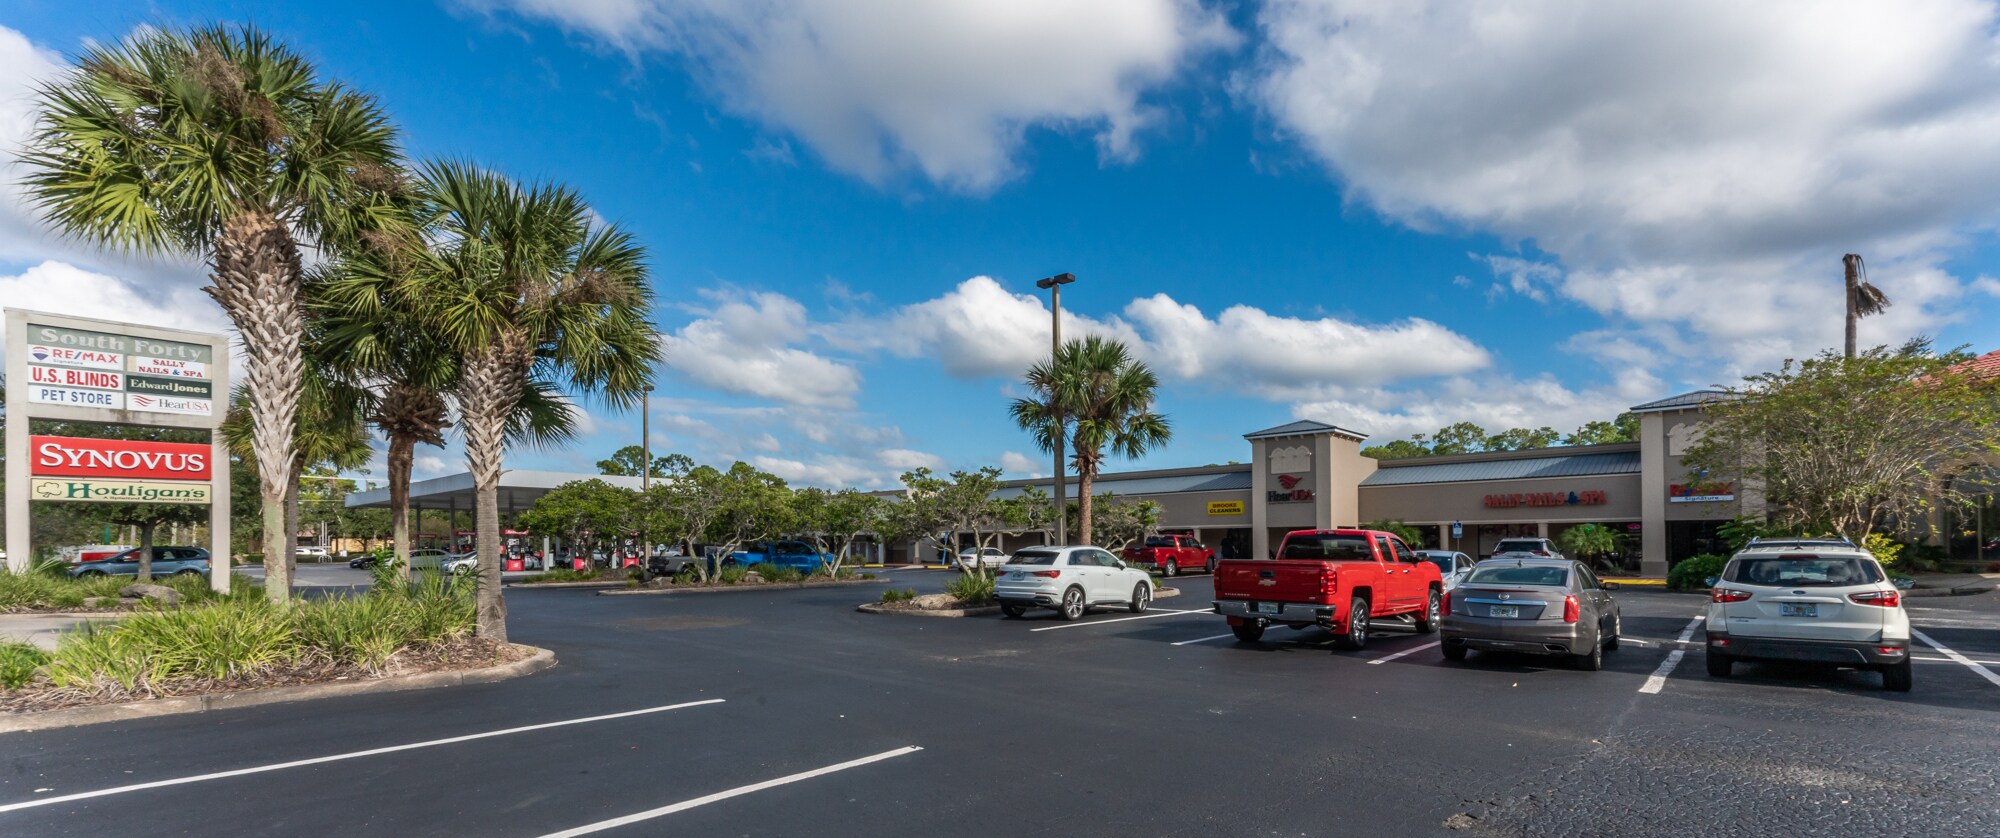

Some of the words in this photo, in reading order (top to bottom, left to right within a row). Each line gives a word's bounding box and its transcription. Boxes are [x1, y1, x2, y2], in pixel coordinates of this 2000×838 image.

[40, 328, 124, 350] South
[134, 340, 203, 361] Forty
[52, 349, 118, 364] RE/MAX
[153, 359, 186, 368] SALLY
[32, 367, 62, 383] U.S.
[66, 370, 119, 388] BLINDS
[138, 366, 169, 375] NAILS
[183, 370, 203, 378] SPA
[41, 388, 66, 401] PET
[71, 391, 112, 405] STORE
[159, 398, 210, 411] HearUSA
[39, 443, 205, 472] SYNOVUS
[64, 482, 205, 500] Houligan's
[1484, 494, 1522, 508] SALLY
[1525, 491, 1566, 507] NAILS
[1567, 491, 1578, 505] &
[1580, 490, 1606, 505] SPA
